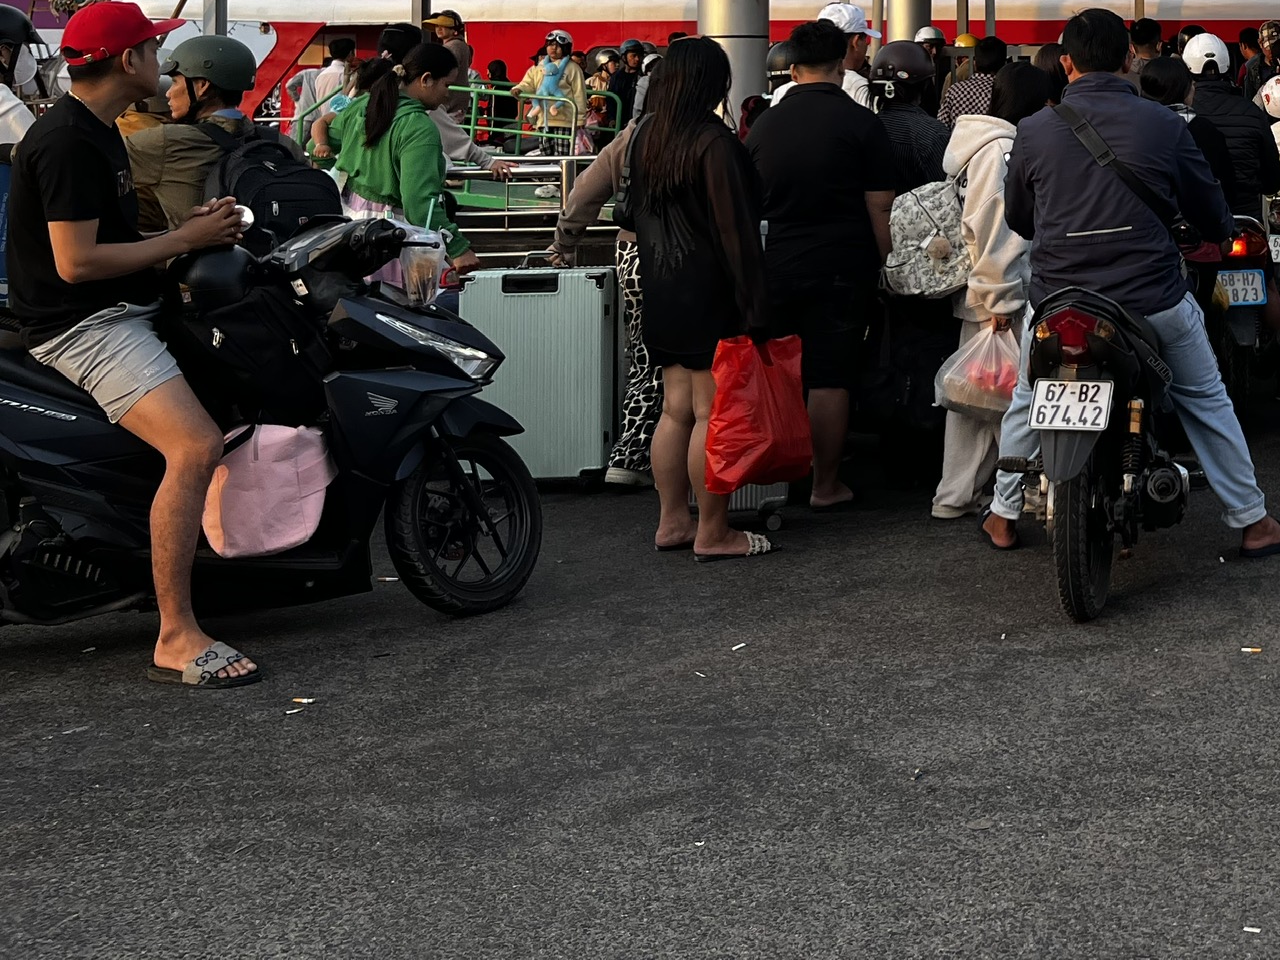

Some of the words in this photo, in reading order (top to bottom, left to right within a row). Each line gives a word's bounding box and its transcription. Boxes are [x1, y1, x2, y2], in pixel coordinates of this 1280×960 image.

[1228, 288, 1259, 303] 823
[1045, 383, 1101, 403] 67-B2
[1035, 405, 1103, 427] 674.42
